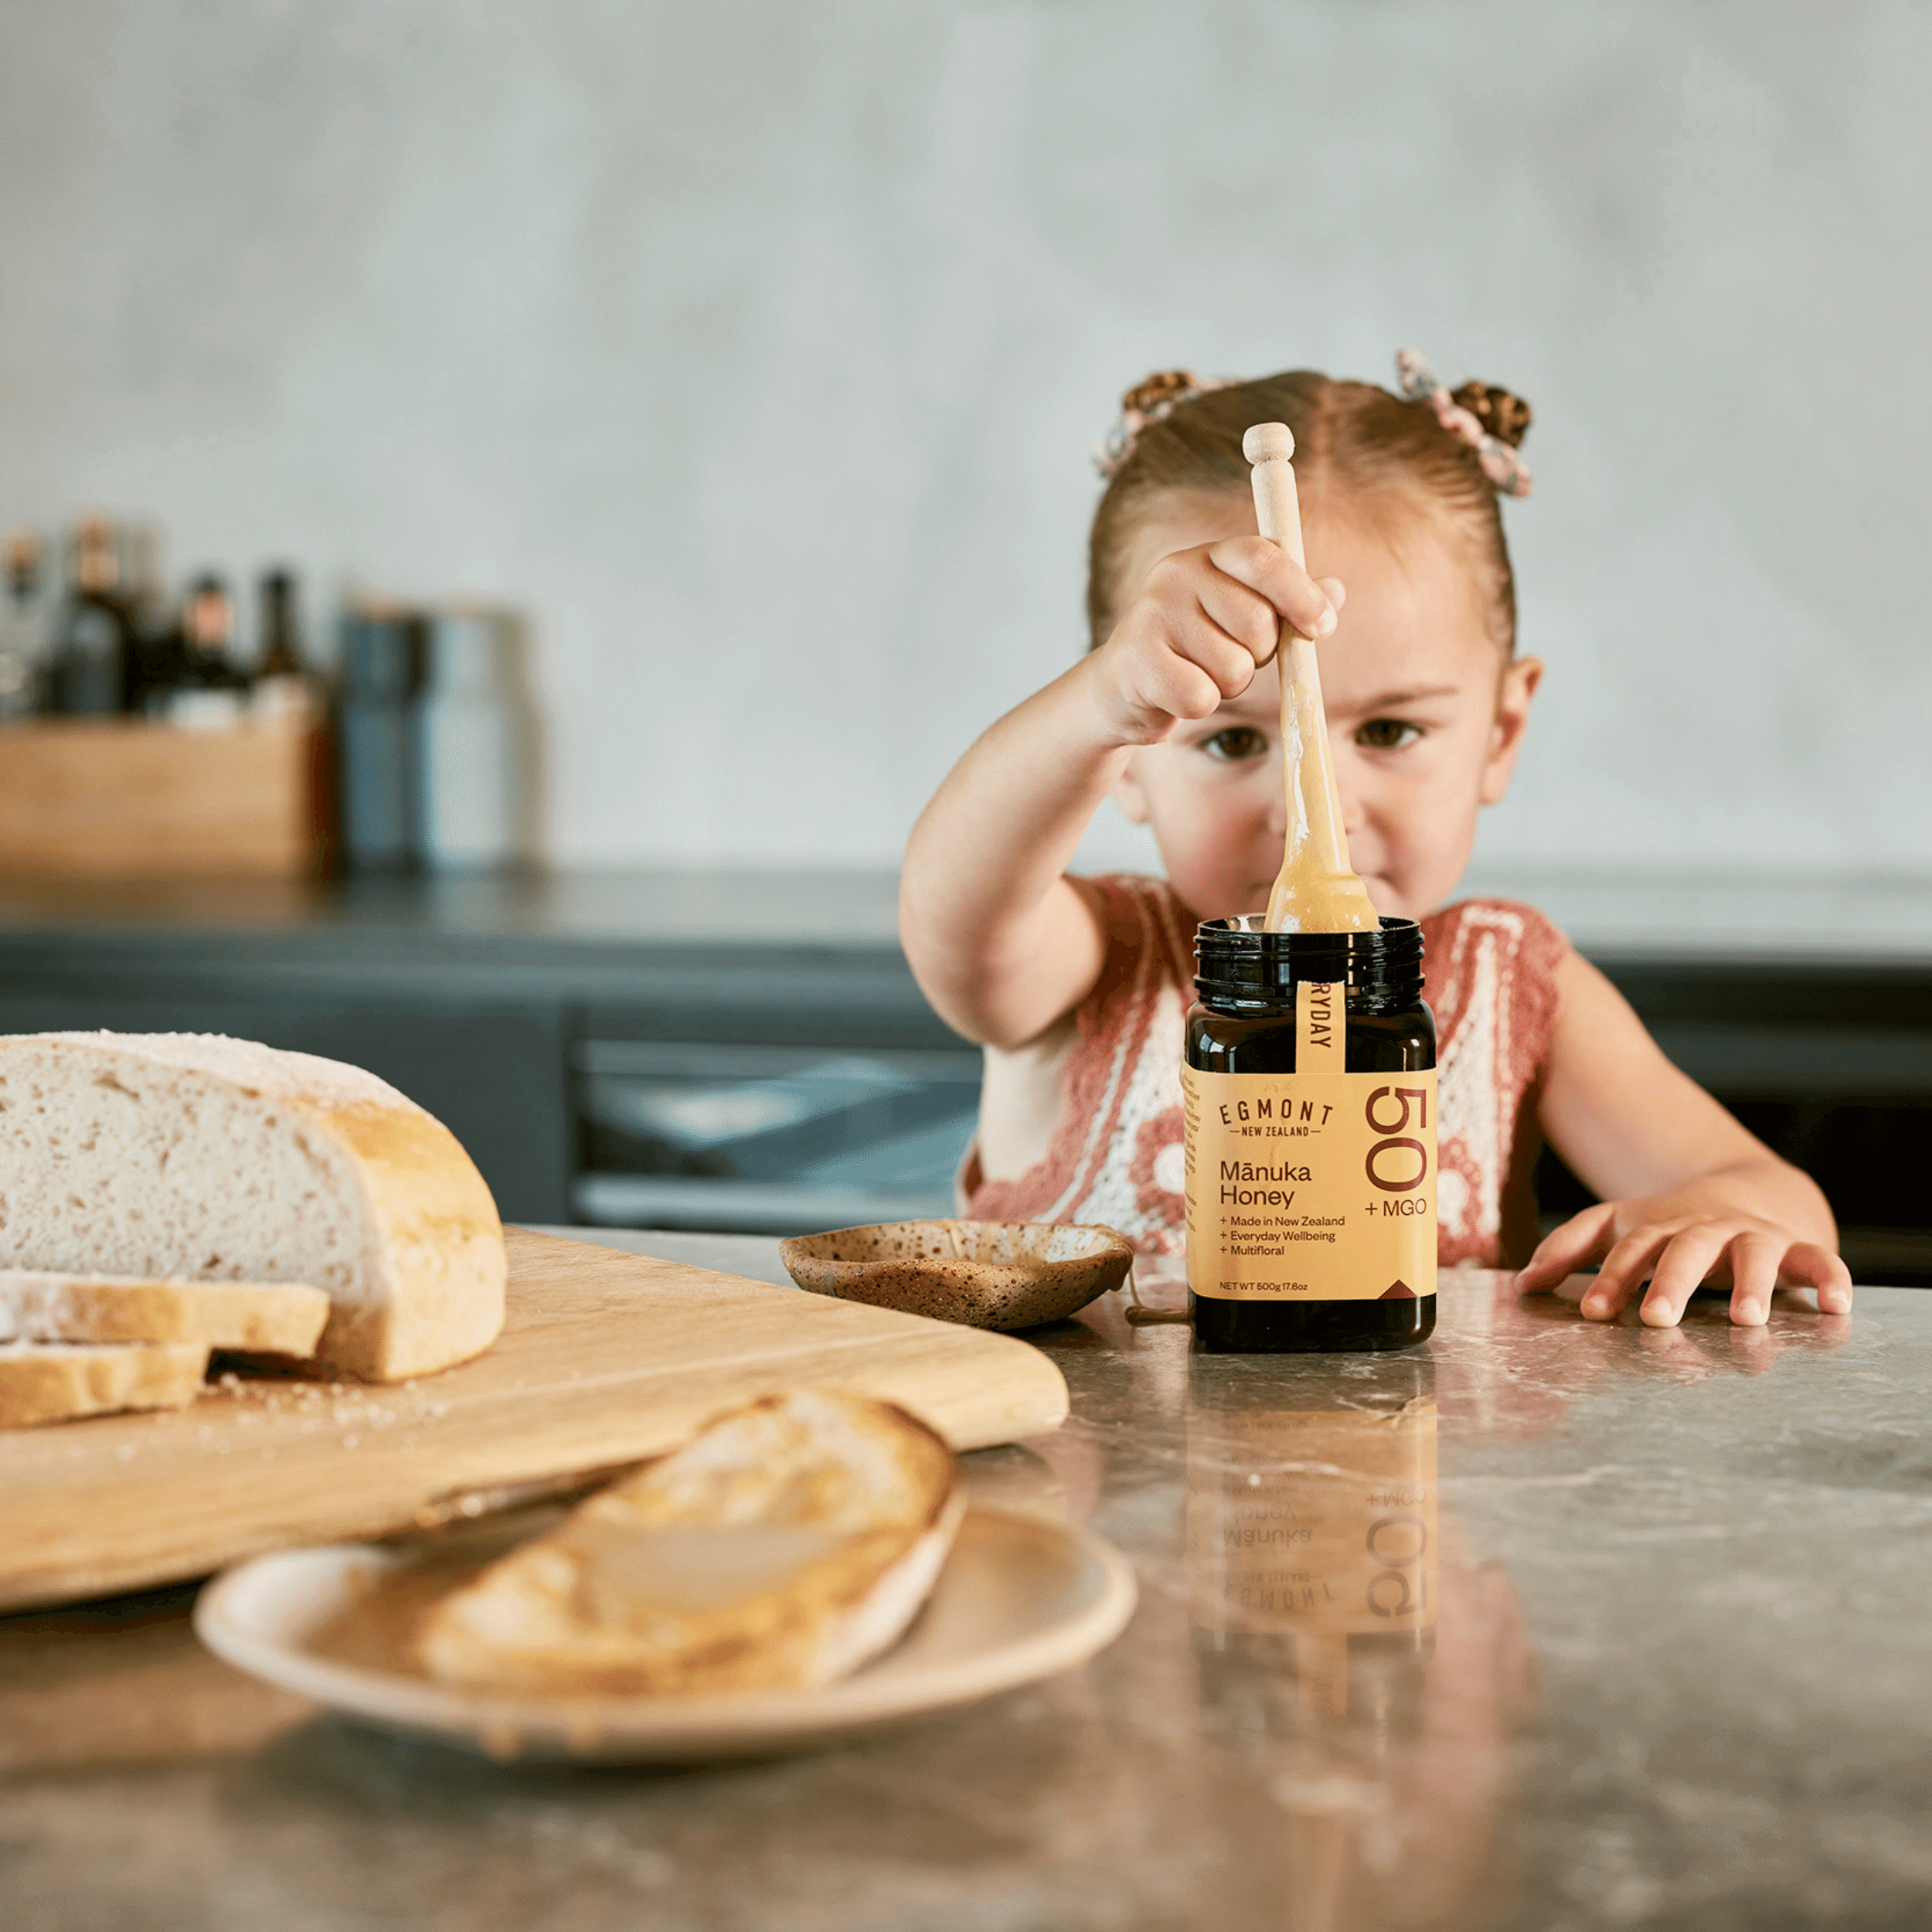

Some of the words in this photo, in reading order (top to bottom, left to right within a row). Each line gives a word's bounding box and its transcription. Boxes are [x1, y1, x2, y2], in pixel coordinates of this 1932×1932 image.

[1310, 984, 1332, 1049] RYDAY
[1219, 1098, 1333, 1125] EGMONT
[1241, 1126, 1263, 1137] NEW
[1265, 1126, 1309, 1137] ZEALAND
[1365, 1086, 1427, 1192] 50
[1220, 1160, 1312, 1182] Mānuka
[1220, 1184, 1295, 1210] Honey
[1383, 1198, 1427, 1217] MGO
[1230, 1216, 1261, 1226] Made
[1263, 1216, 1273, 1226] in
[1275, 1216, 1299, 1226] New
[1301, 1216, 1345, 1226] Zealand
[1230, 1230, 1281, 1243] Everyday
[1283, 1230, 1336, 1243] Wellbeing
[1230, 1245, 1285, 1256] Multifloral
[1219, 1281, 1237, 1291] NET
[1239, 1281, 1255, 1291] WT
[1257, 1281, 1281, 1292] 500g
